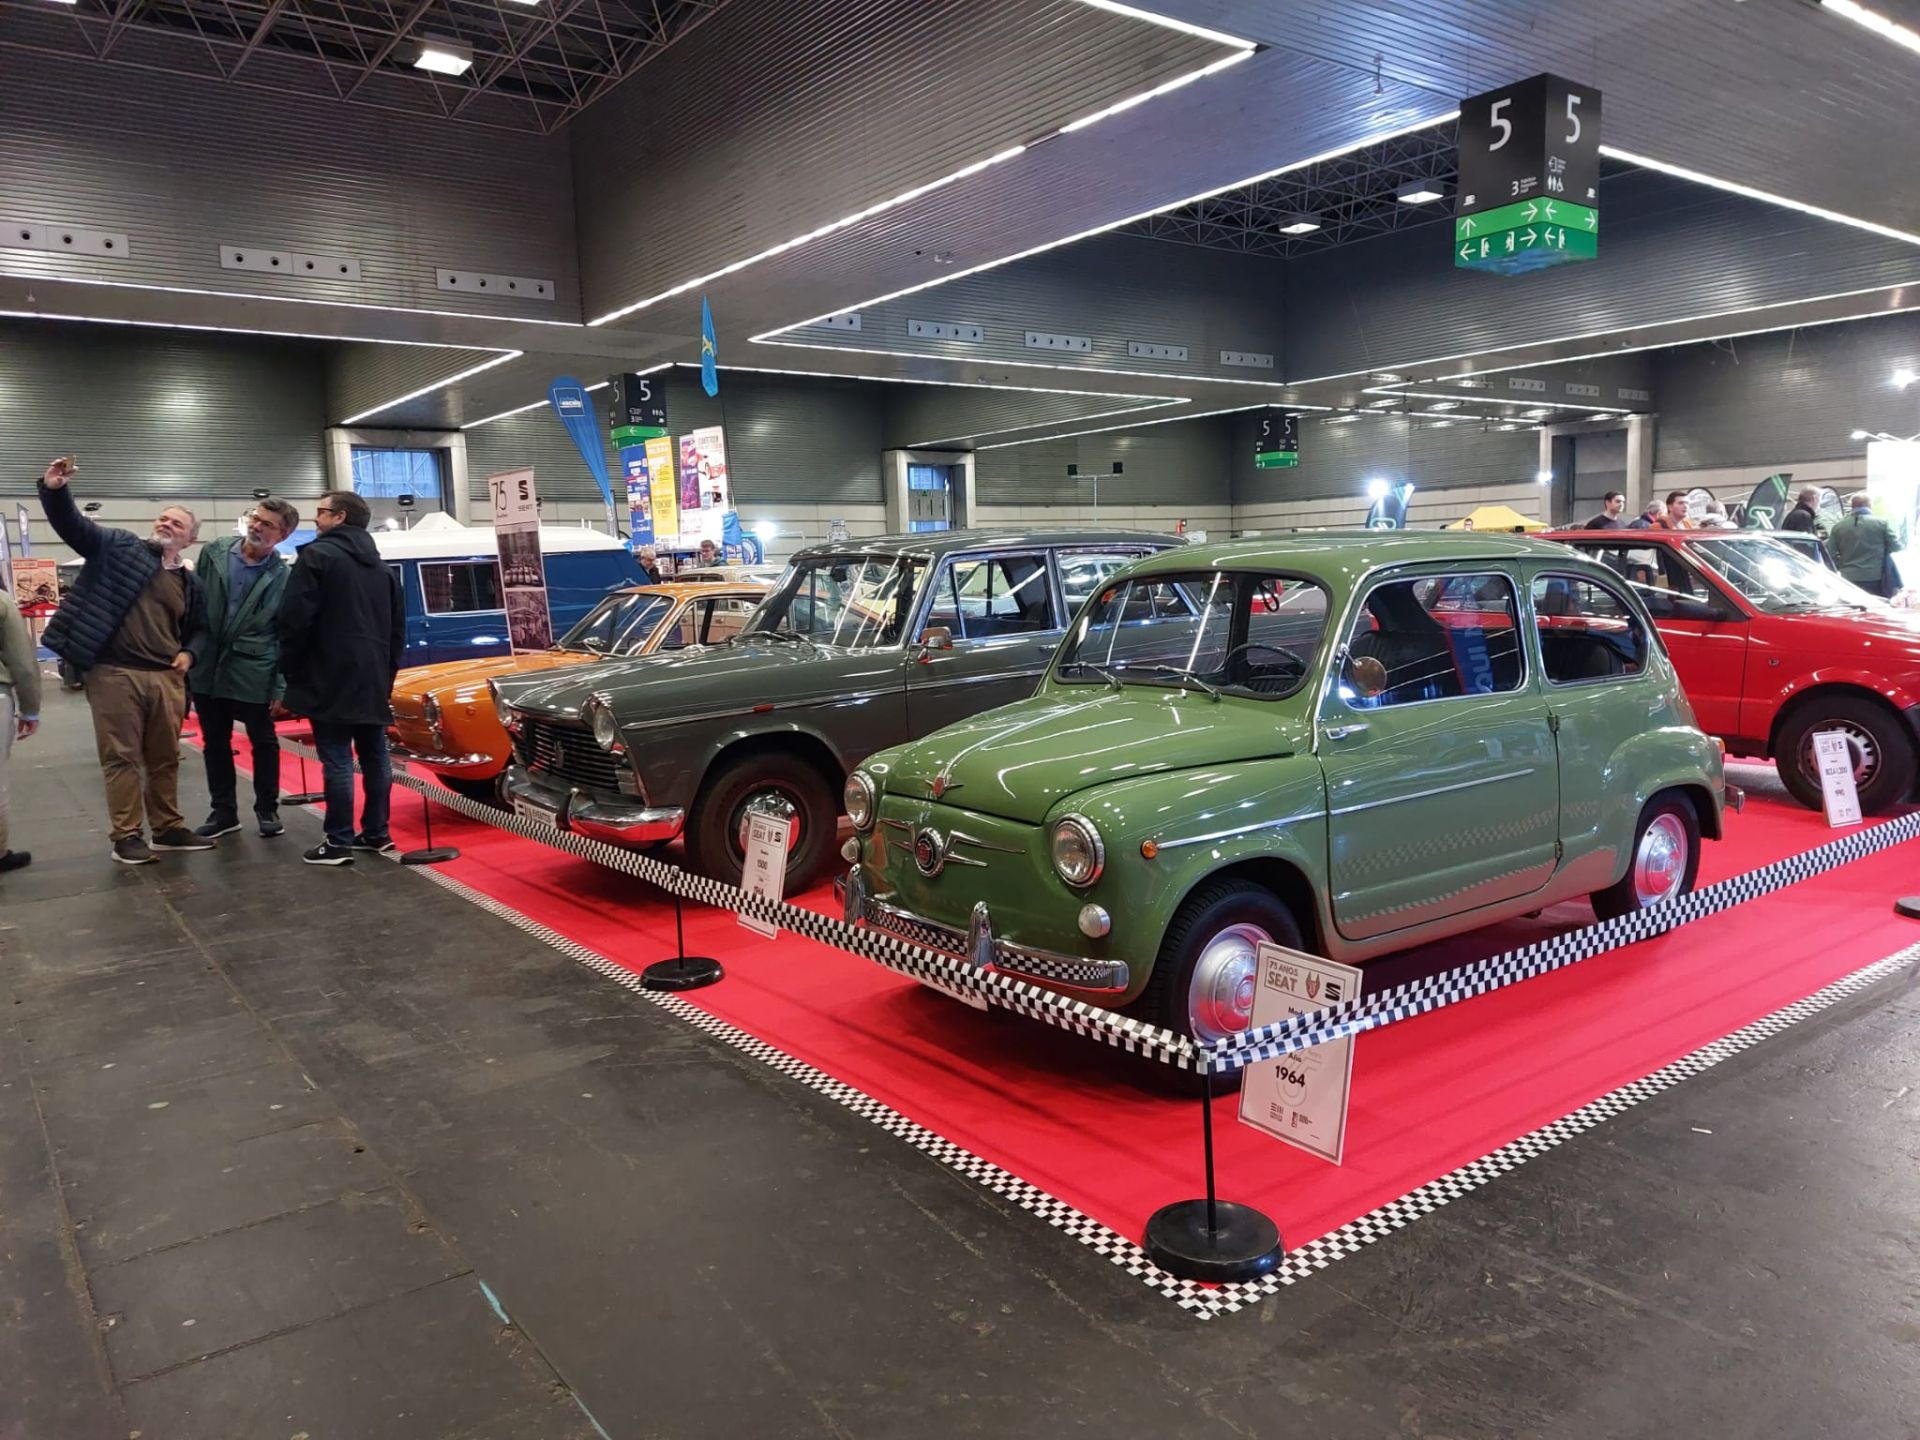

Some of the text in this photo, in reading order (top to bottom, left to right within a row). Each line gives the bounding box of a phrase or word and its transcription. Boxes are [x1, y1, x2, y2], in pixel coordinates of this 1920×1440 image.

[1489, 98, 1512, 151] 5
[1566, 93, 1581, 143] 5
[1511, 180, 1520, 196] 3
[639, 379, 652, 401] 5
[1263, 420, 1270, 436] 5
[1285, 419, 1291, 434] 5
[491, 480, 508, 510] 75
[1269, 960, 1278, 970] 75
[1268, 971, 1298, 992] SEAT
[1275, 1064, 1306, 1088] 1964
